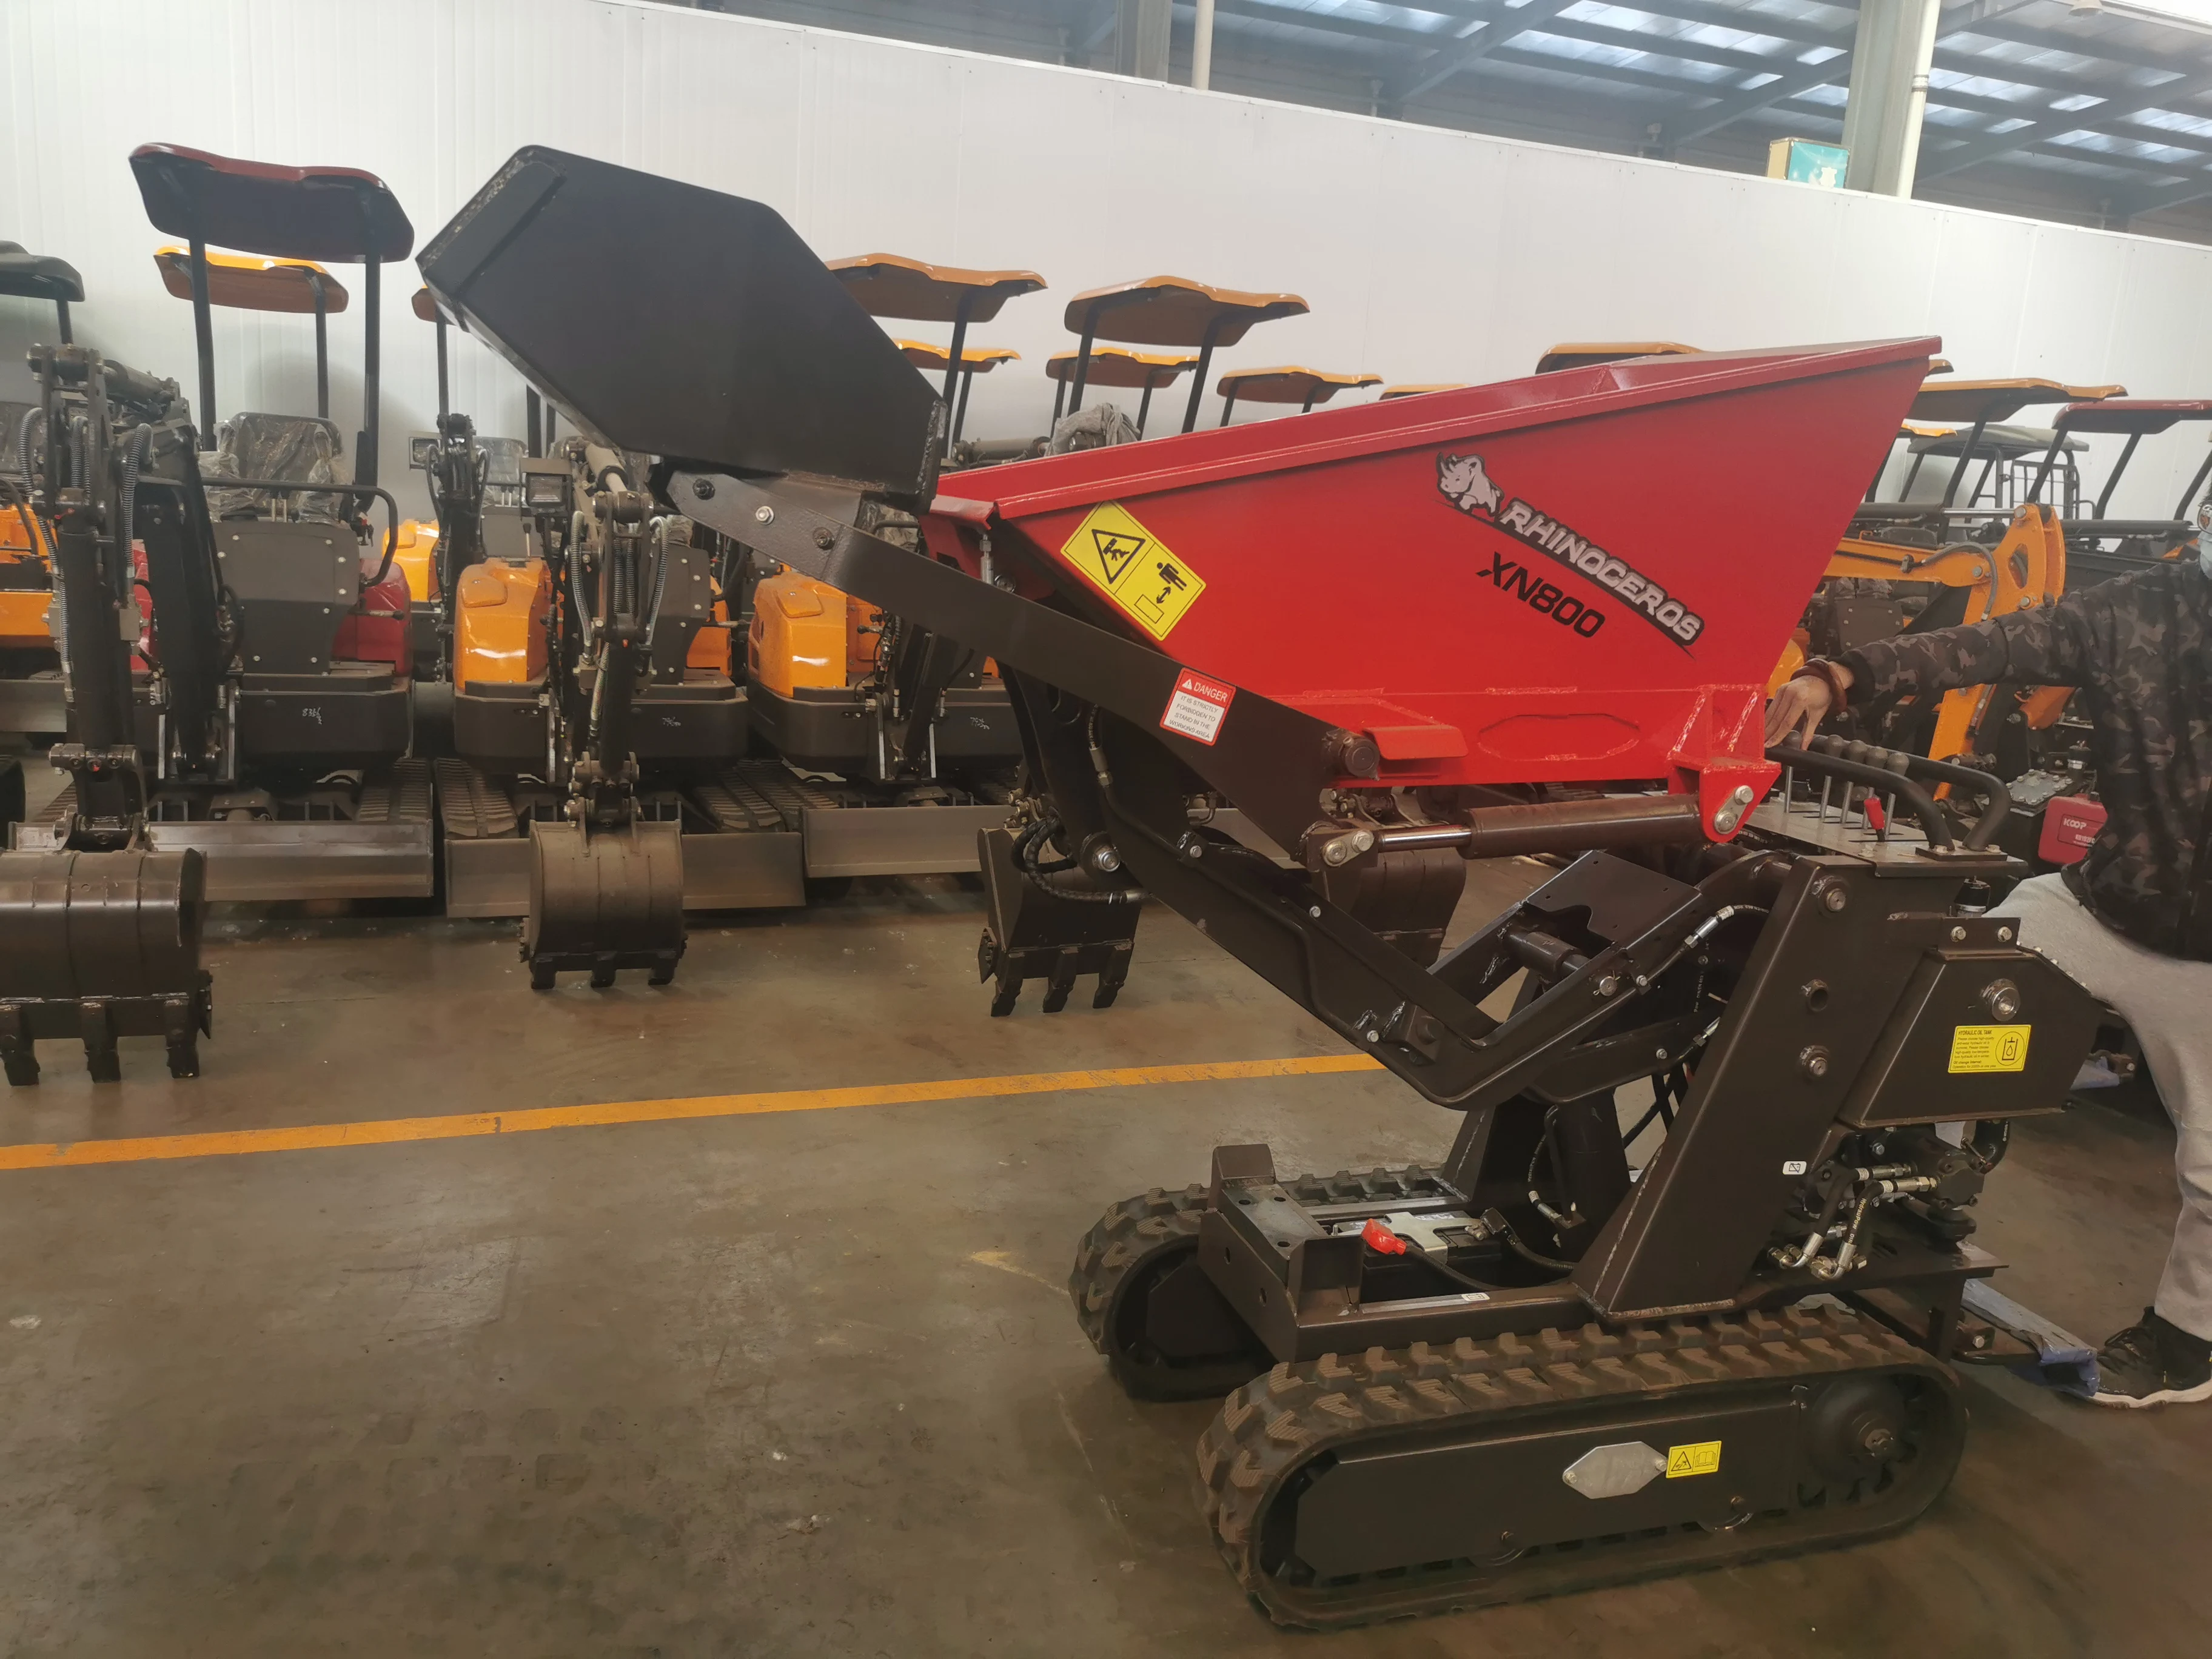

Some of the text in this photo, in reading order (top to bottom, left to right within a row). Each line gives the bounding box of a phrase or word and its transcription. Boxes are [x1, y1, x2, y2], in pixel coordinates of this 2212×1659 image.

[1499, 498, 1703, 643] RHINOCEROS
[1476, 551, 1606, 638] XN800
[1193, 681, 1228, 703] DANGER
[1176, 703, 1208, 719] FORBIDDEN
[1193, 700, 1219, 714] STRICTLY
[1174, 712, 1193, 723] STAND
[1200, 721, 1211, 731] THE
[1196, 729, 1210, 739] AREA
[2063, 818, 2087, 830] KOOP
[1852, 1198, 1868, 1230] HydrauPow
